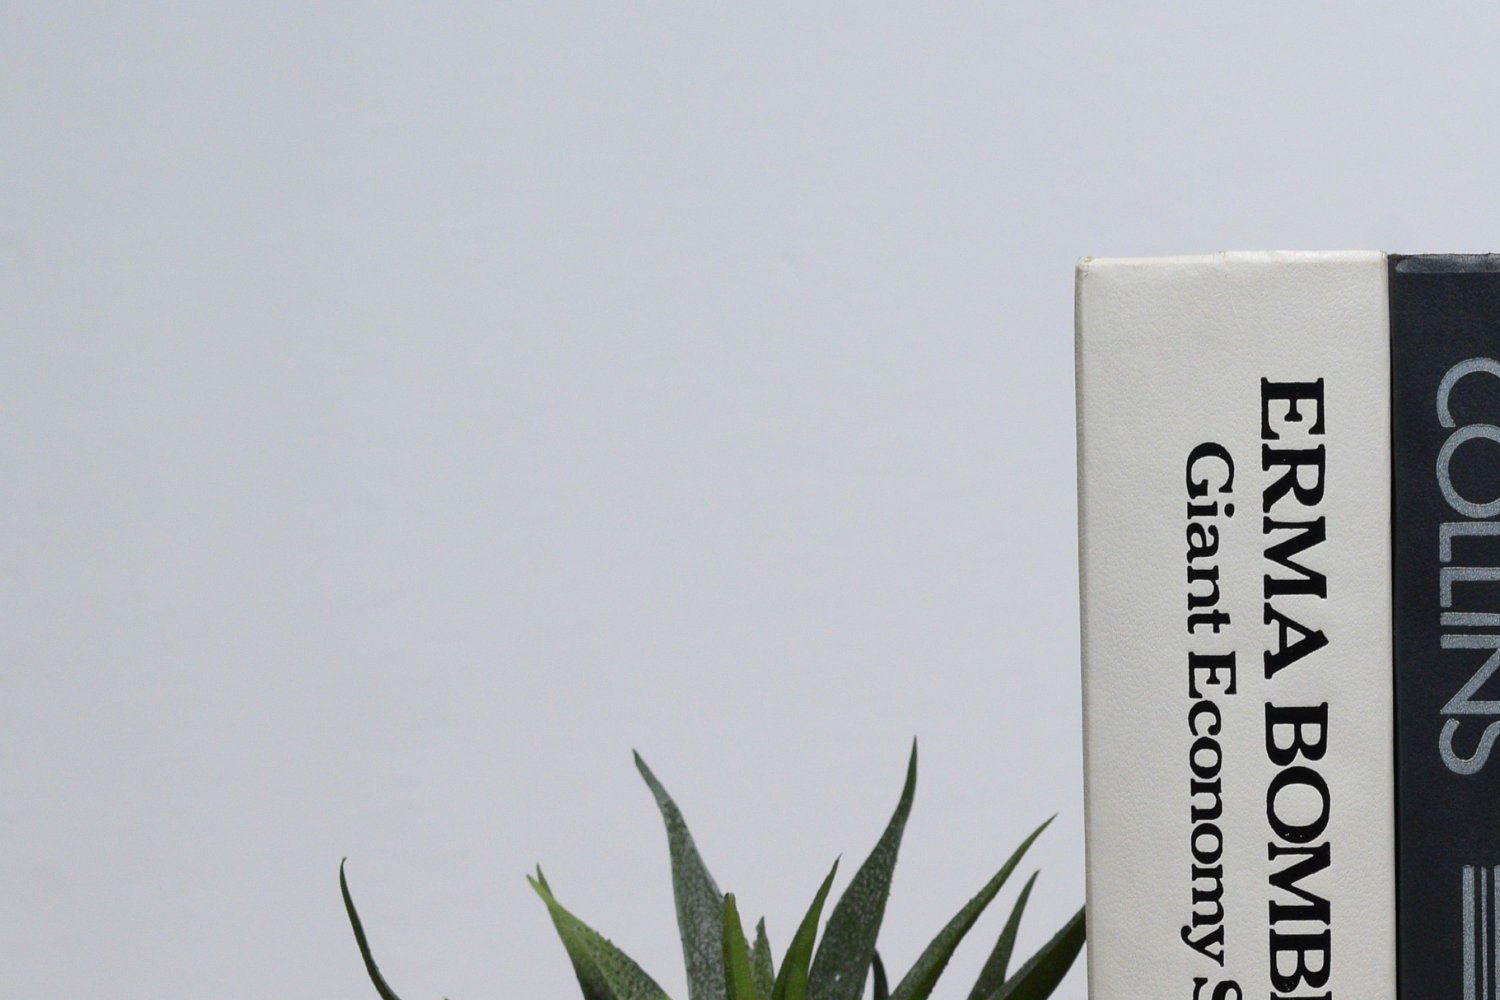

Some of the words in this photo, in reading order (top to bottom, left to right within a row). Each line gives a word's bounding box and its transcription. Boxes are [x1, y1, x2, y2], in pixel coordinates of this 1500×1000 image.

[1185, 441, 1235, 635] Giant
[1260, 376, 1330, 680] ERMA
[1180, 650, 1237, 968] Economy
